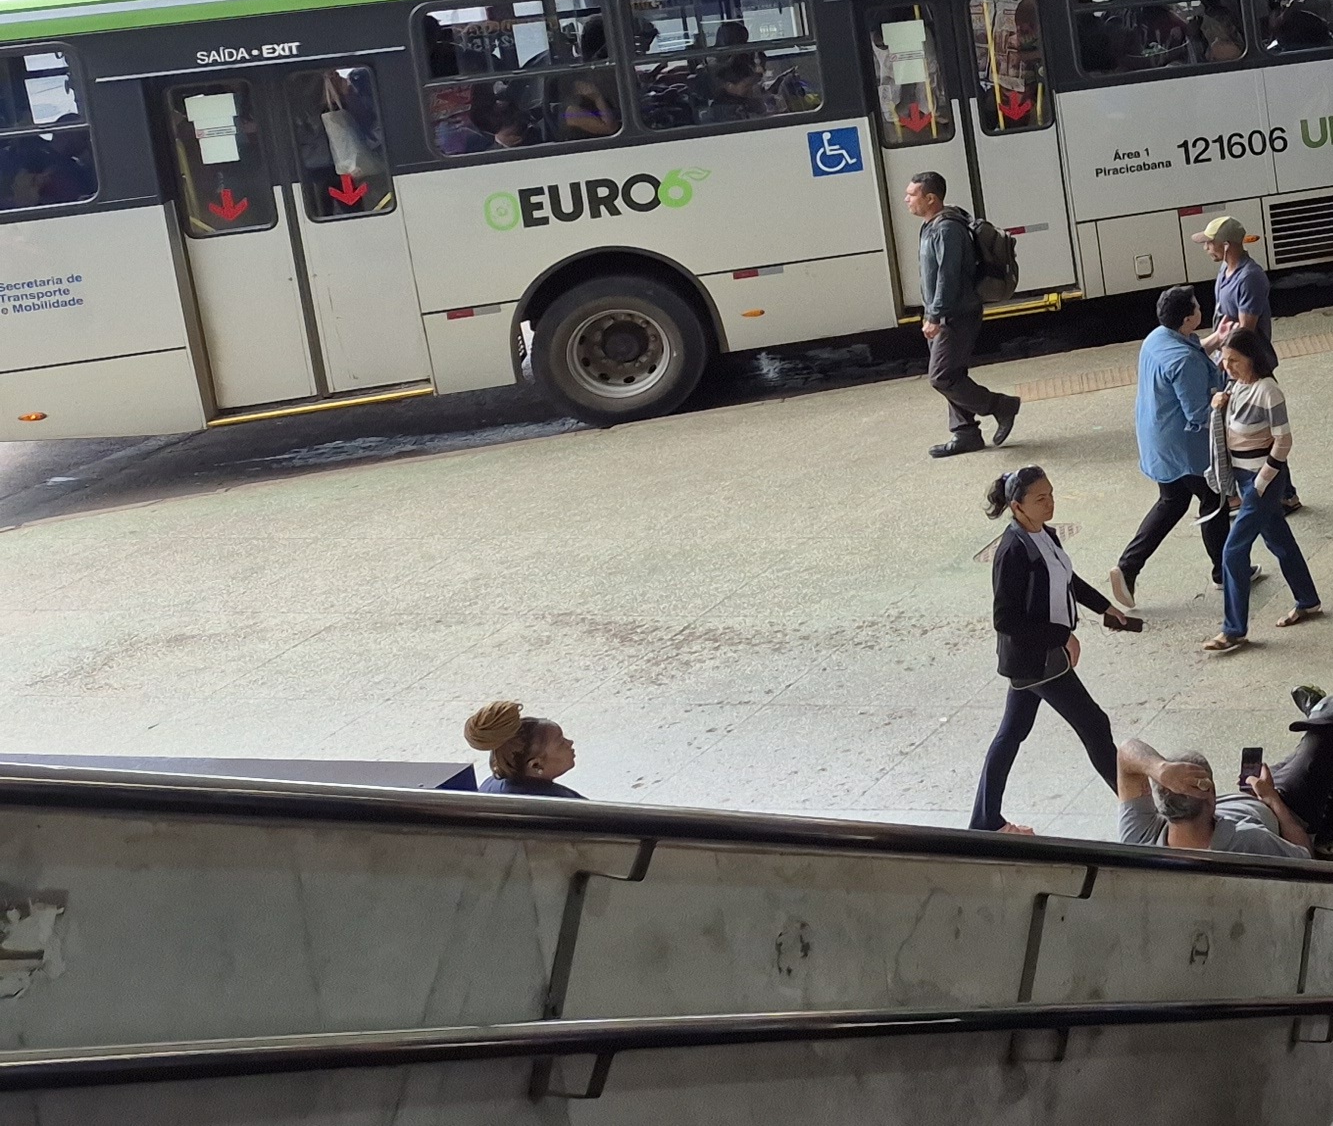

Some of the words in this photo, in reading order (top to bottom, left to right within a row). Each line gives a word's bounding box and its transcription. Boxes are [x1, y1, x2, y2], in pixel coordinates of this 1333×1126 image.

[196, 46, 250, 64] SAÍDA
[262, 42, 302, 58] EXIT
[1113, 148, 1140, 162] Área
[1143, 147, 1150, 158] 1
[1177, 126, 1288, 166] 121606
[1095, 158, 1172, 178] Piracicabana
[0, 276, 62, 292] Secretaria
[66, 274, 82, 284] de
[0, 288, 70, 304] Transporte
[12, 297, 84, 314] Mobilidade
